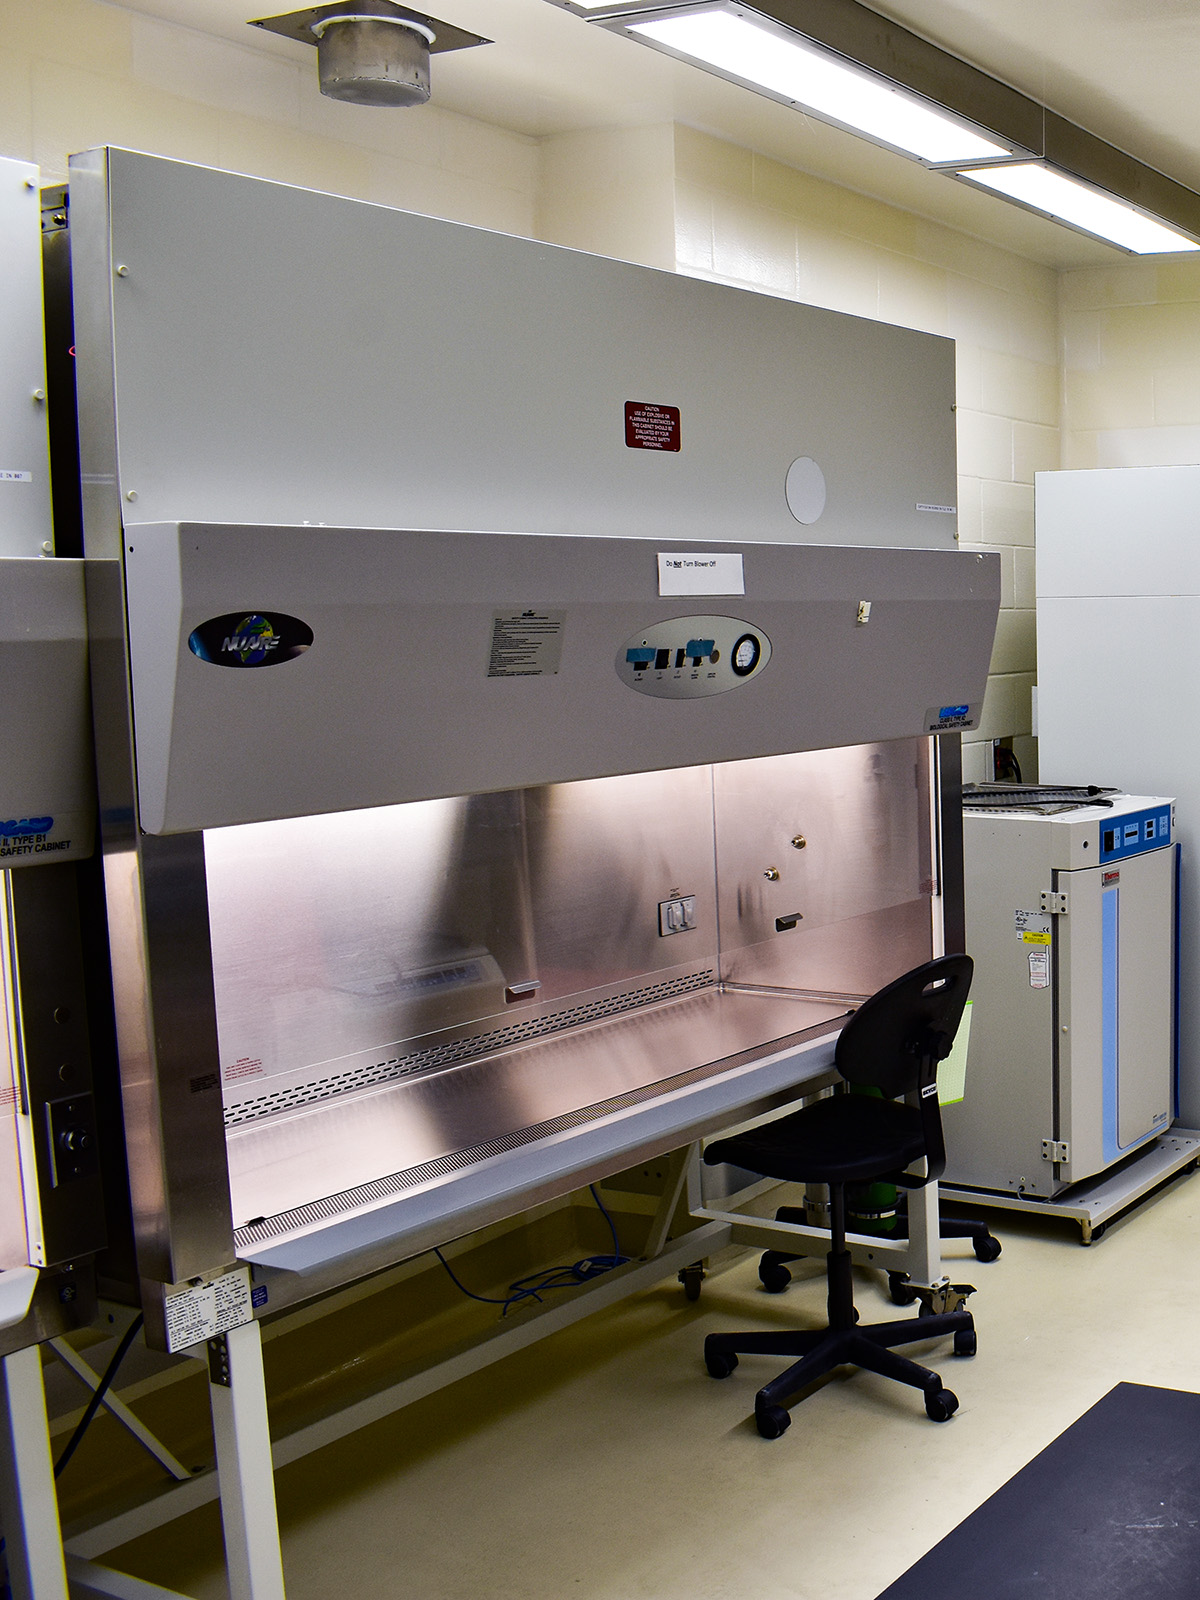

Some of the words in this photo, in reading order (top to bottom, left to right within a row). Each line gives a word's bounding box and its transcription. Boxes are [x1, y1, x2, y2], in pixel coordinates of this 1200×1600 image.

[673, 560, 682, 568] Not
[12, 834, 35, 846] TYPE
[36, 834, 47, 843] B1
[0, 844, 34, 857] SAFETY
[34, 840, 72, 853] CABINET
